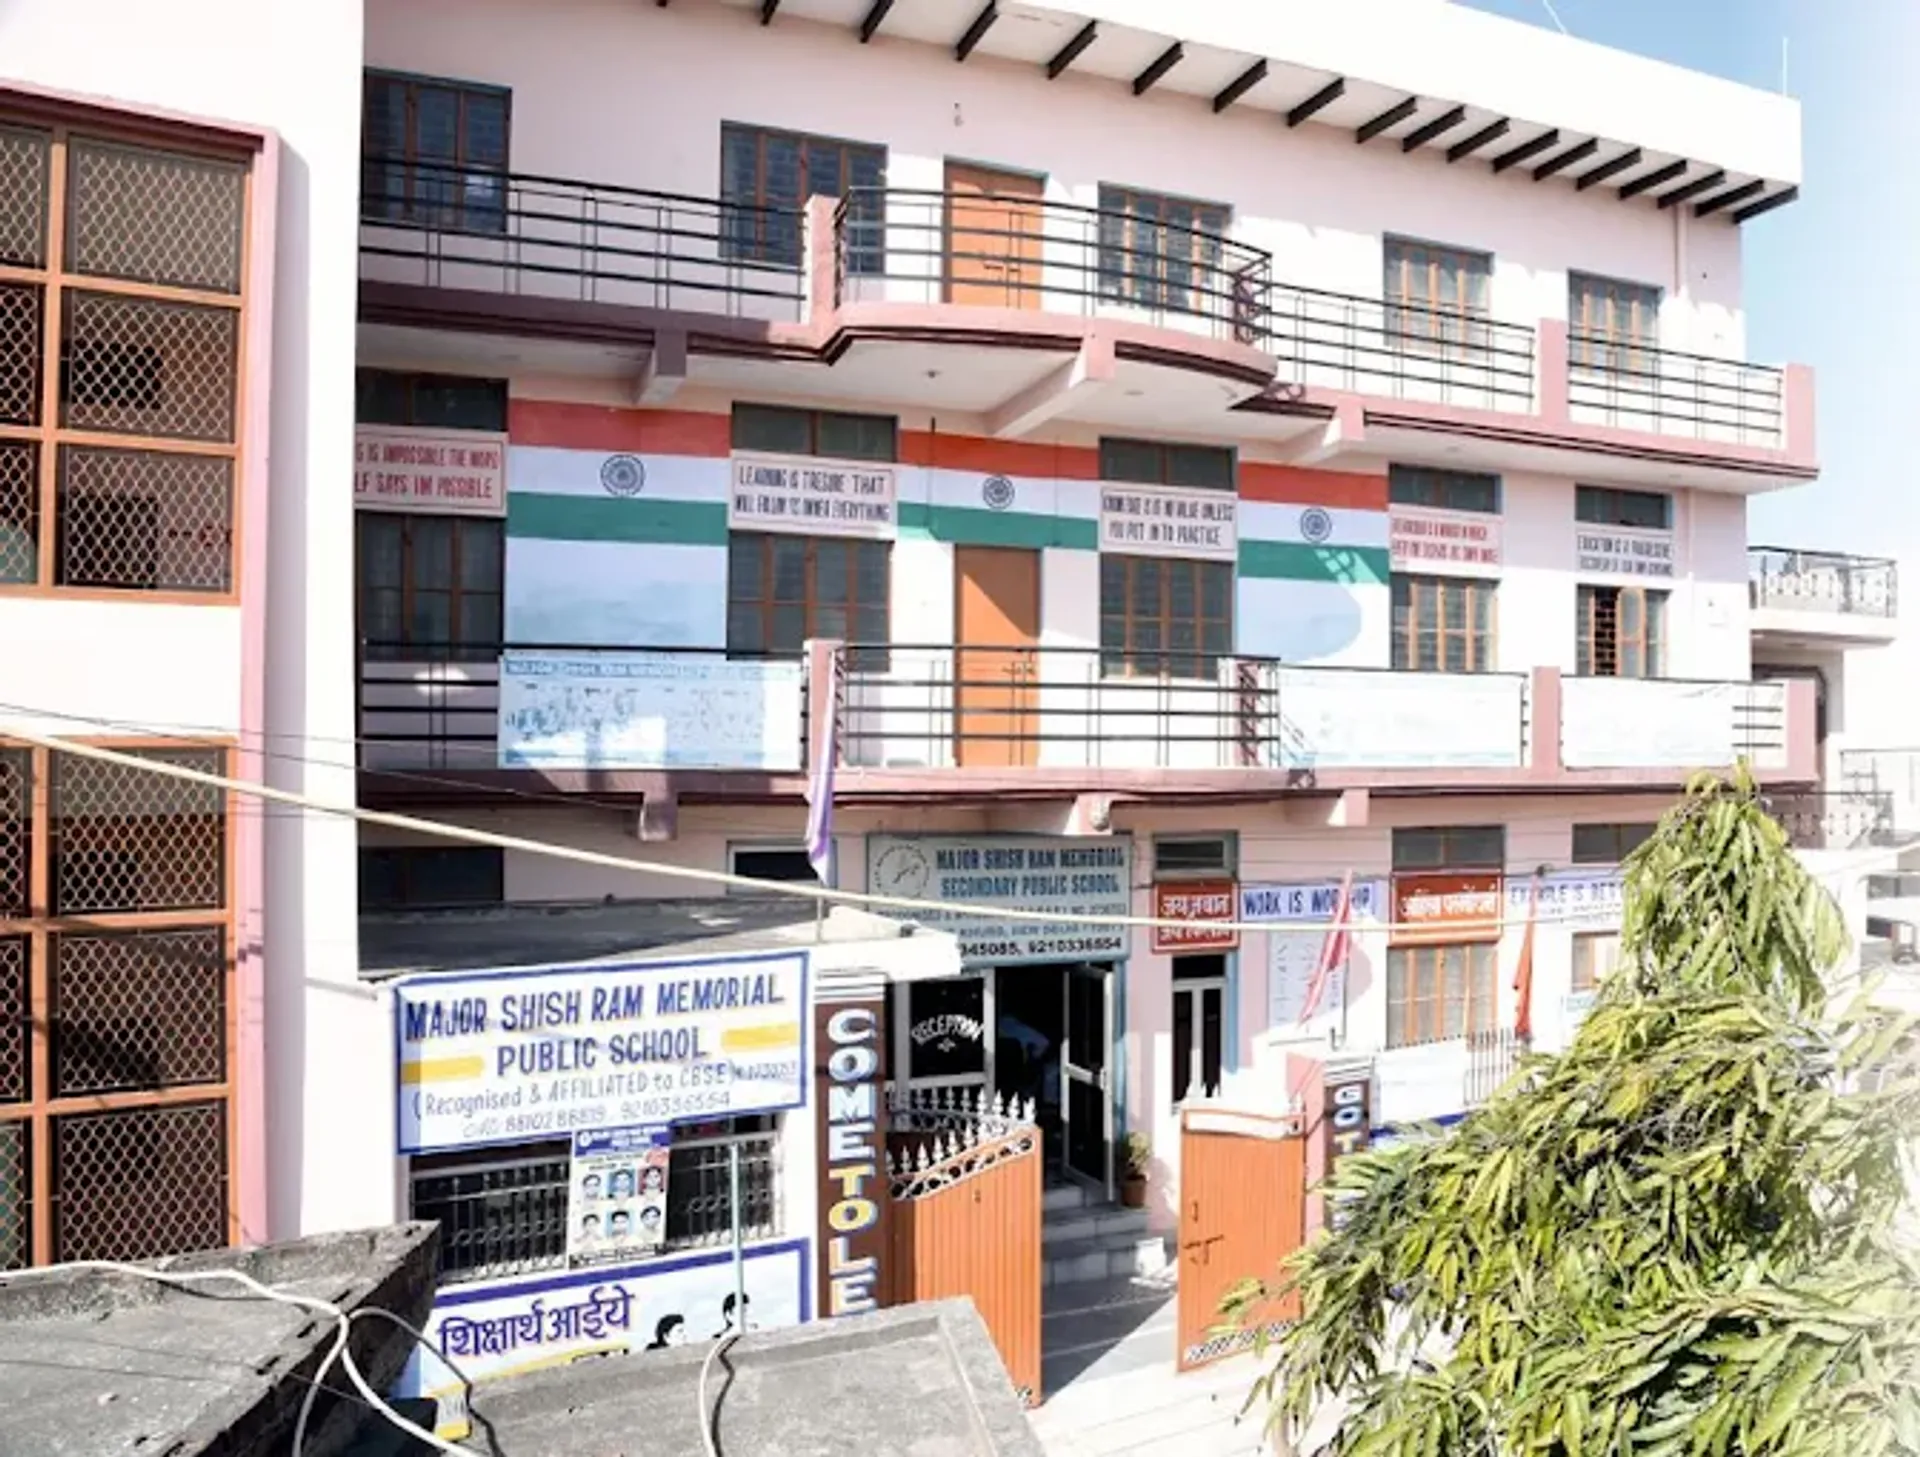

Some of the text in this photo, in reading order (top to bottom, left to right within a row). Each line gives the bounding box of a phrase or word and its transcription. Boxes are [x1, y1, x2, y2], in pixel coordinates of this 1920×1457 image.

[852, 474, 885, 495] THAT
[937, 847, 1123, 870] MAJOR SHISH RAM MEMORIAL
[941, 875, 1119, 897] SECONDARY PUBLIC SCHOOL
[1244, 891, 1280, 916] WORK
[1289, 890, 1302, 913] IS
[406, 974, 785, 1041] MAJOR SHISH RAM MEMORIAL
[910, 1013, 985, 1045] RECEPTION
[497, 1026, 709, 1076] PUBLIC SCHOOL
[653, 1075, 673, 1092] to
